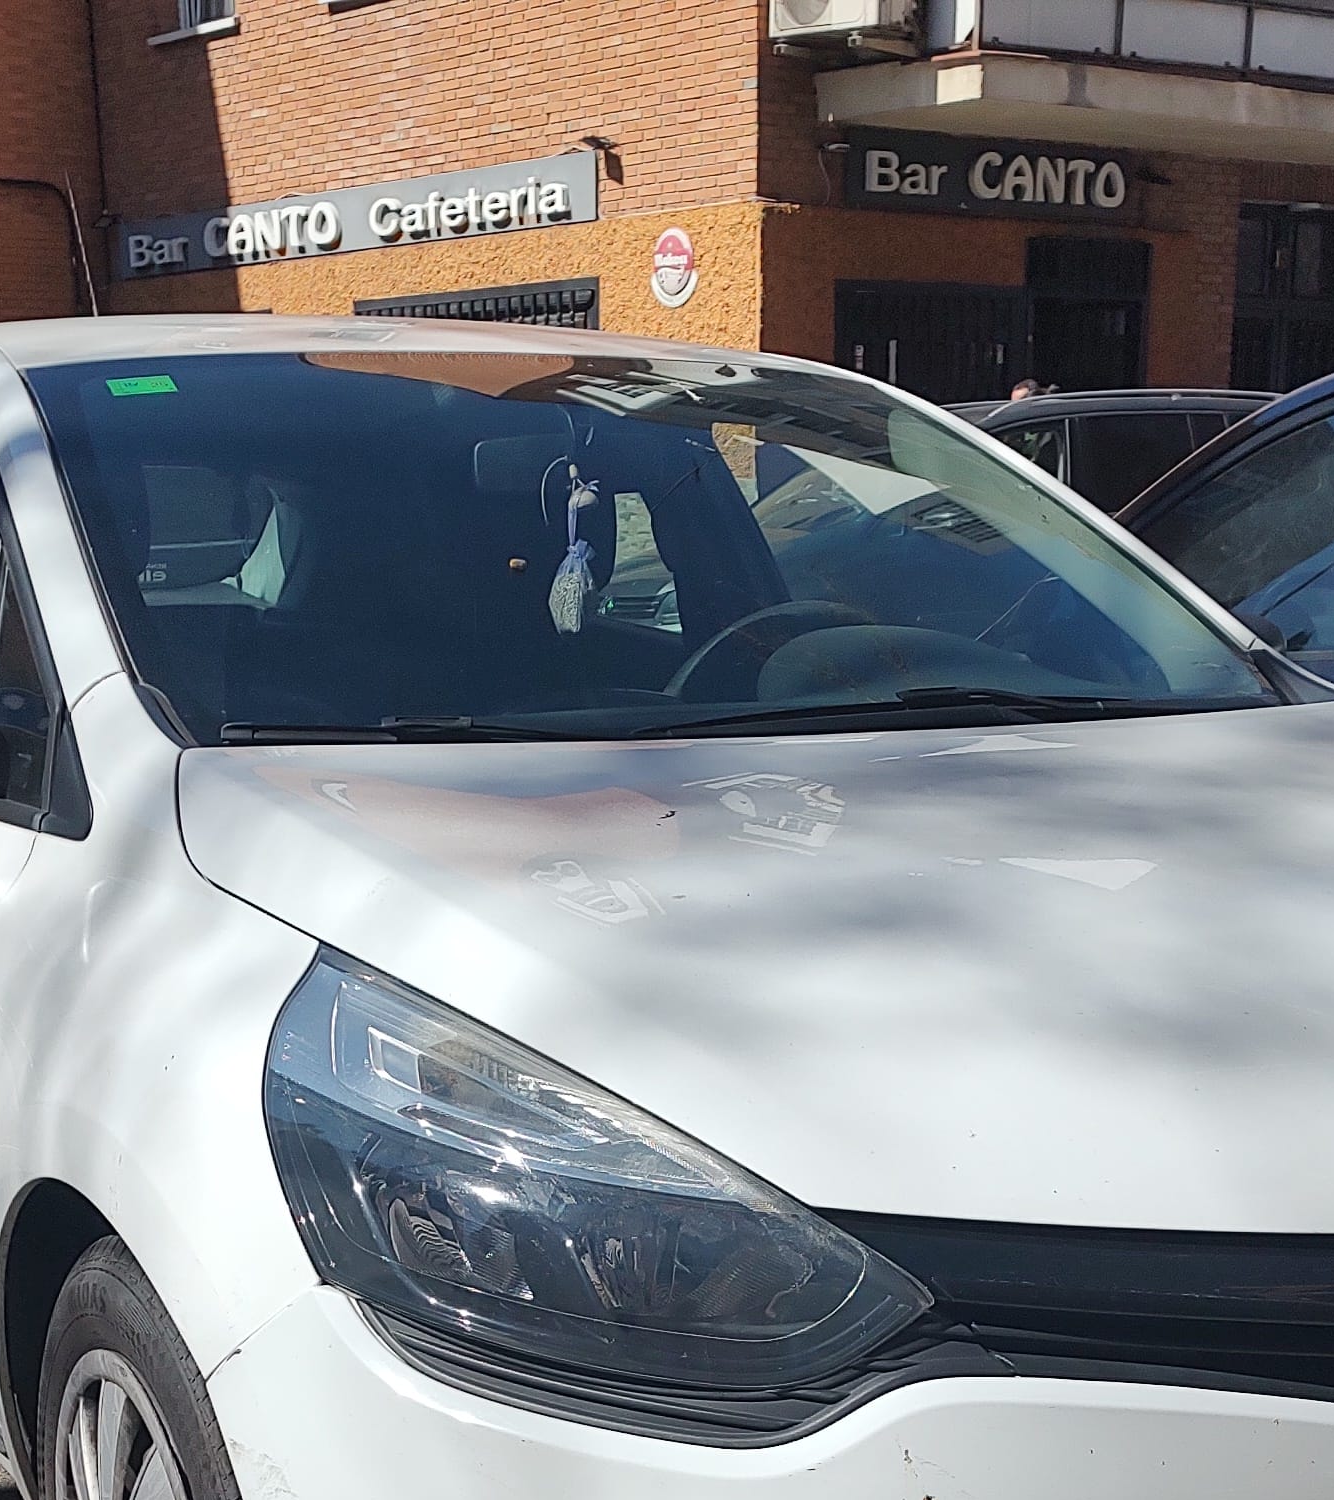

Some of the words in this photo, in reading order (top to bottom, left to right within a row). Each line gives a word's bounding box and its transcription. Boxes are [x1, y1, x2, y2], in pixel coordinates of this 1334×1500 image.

[865, 150, 948, 196] Bar
[969, 151, 1126, 208] CANTO
[128, 234, 189, 268] Bar
[204, 201, 340, 257] CANTO
[369, 177, 571, 237] Cafeteria
